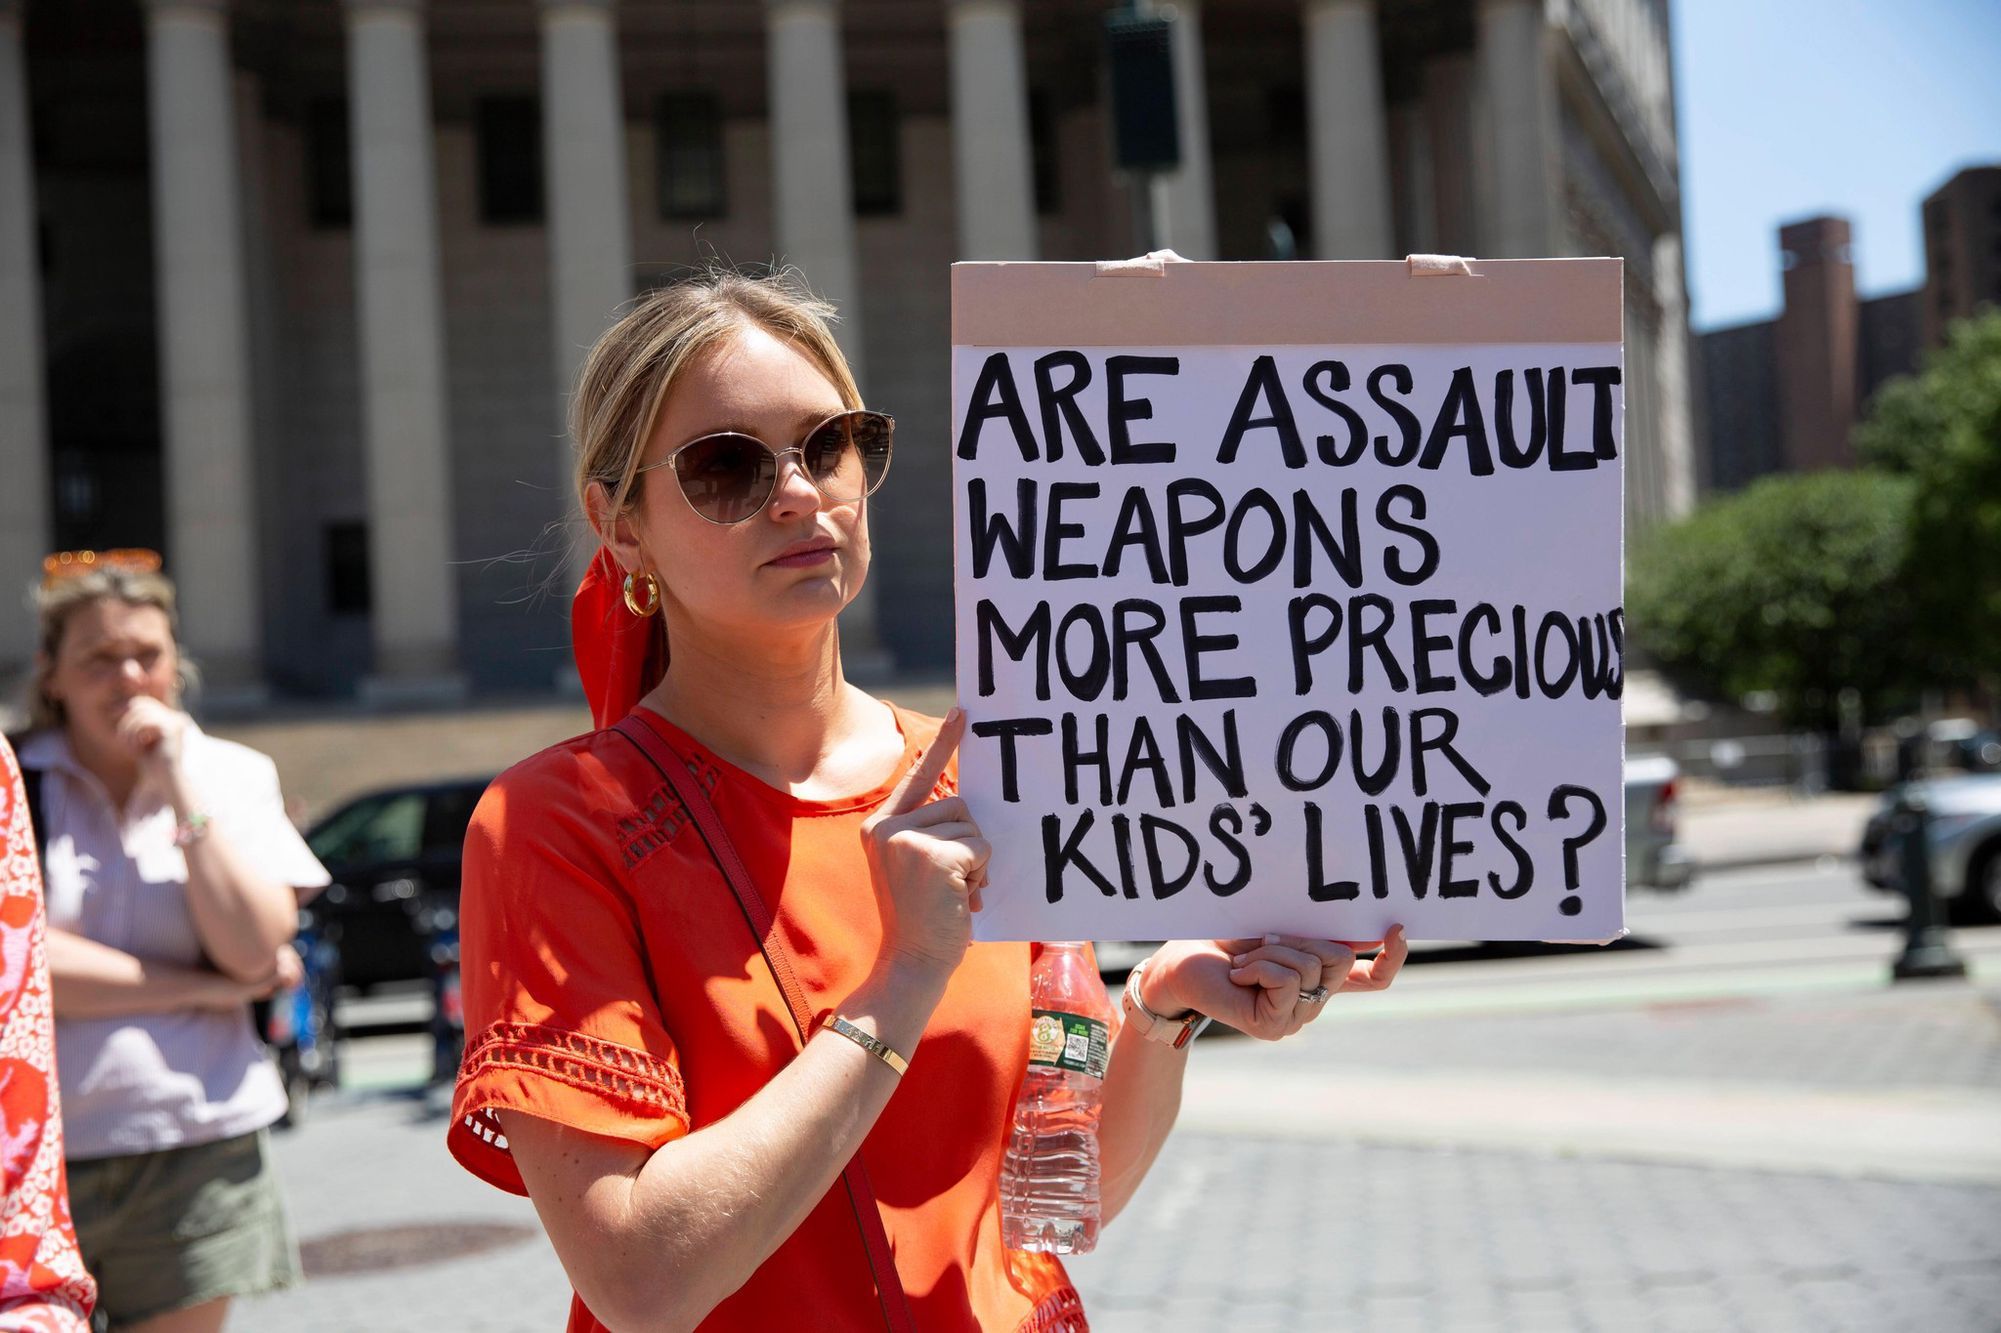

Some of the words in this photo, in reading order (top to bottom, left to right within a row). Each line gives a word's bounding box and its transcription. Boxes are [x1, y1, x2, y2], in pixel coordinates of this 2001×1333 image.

[957, 350, 1180, 466] ARE
[1216, 355, 1622, 476] ASSAULT
[967, 478, 1441, 588] WEAPONS
[976, 595, 1257, 704] MORE
[1287, 592, 1625, 701] PRECIOUS
[971, 708, 1249, 808] THAN
[1274, 706, 1492, 799] OUR
[1303, 783, 1608, 917] LIVES?
